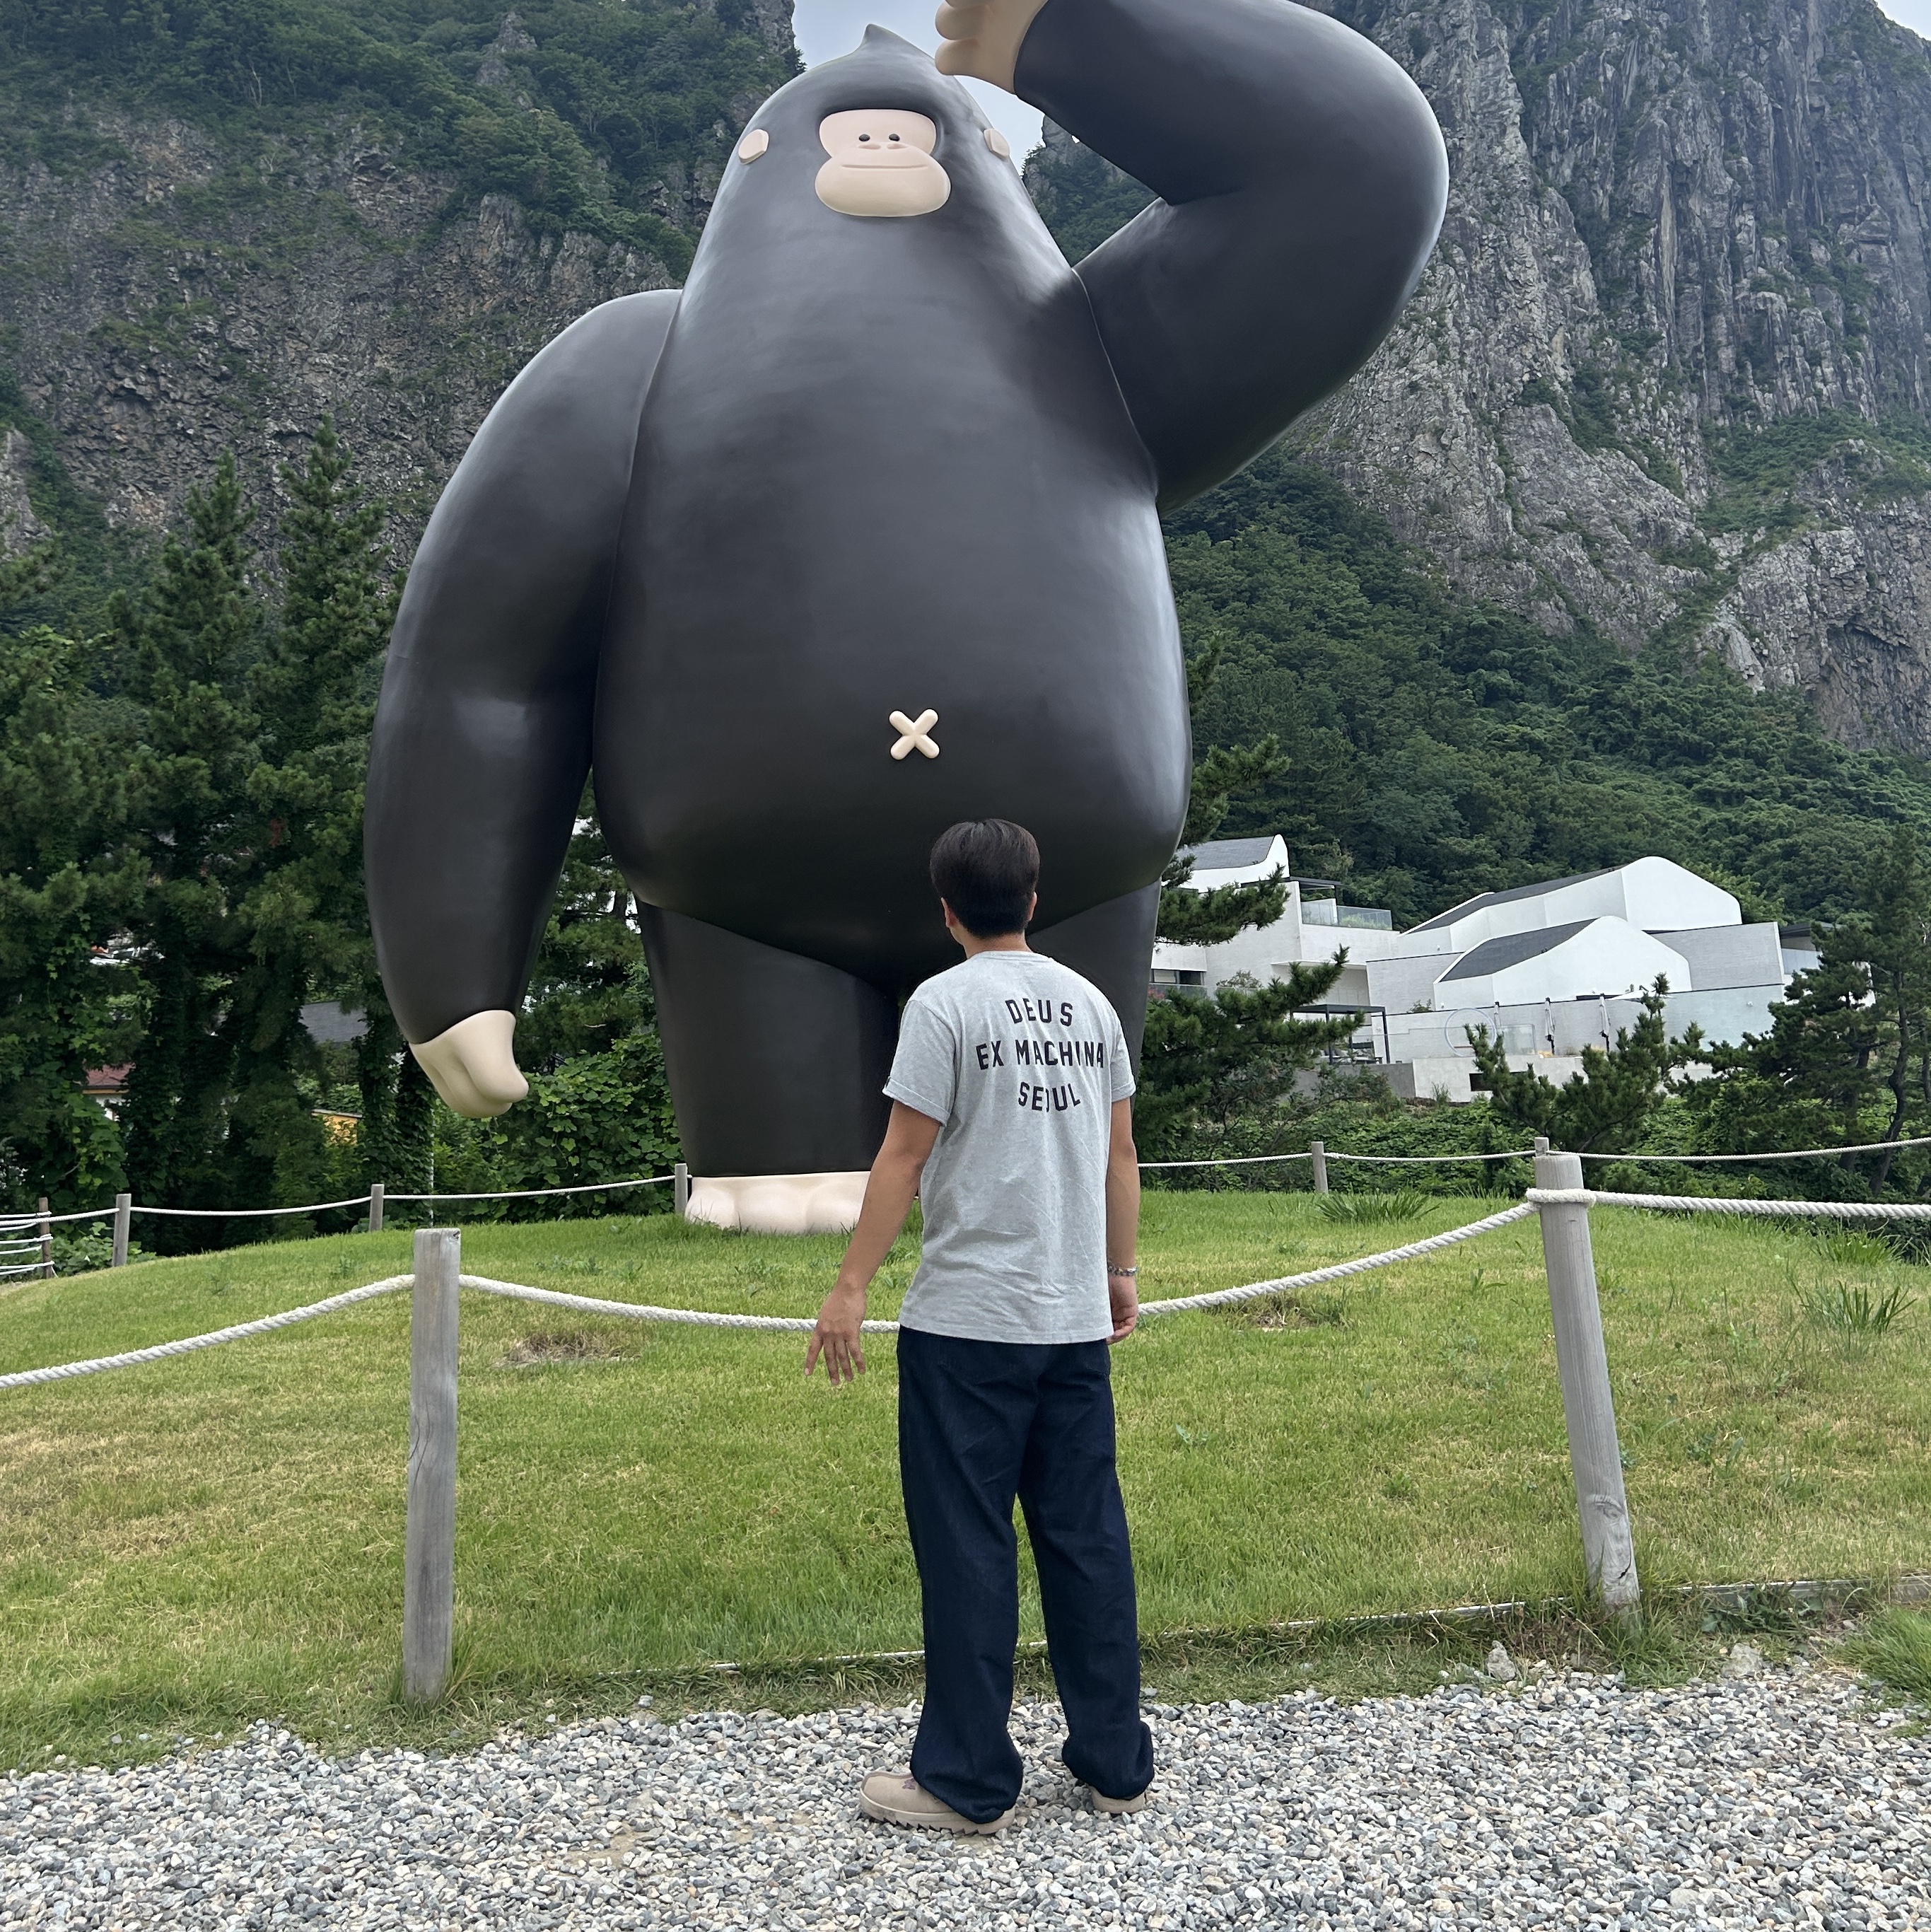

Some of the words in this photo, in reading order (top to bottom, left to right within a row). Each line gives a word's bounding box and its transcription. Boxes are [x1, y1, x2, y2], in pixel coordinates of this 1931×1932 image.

[1005, 997, 1073, 1026] DEUS
[976, 1040, 1004, 1070] EX
[1015, 1040, 1104, 1069] MACHINA
